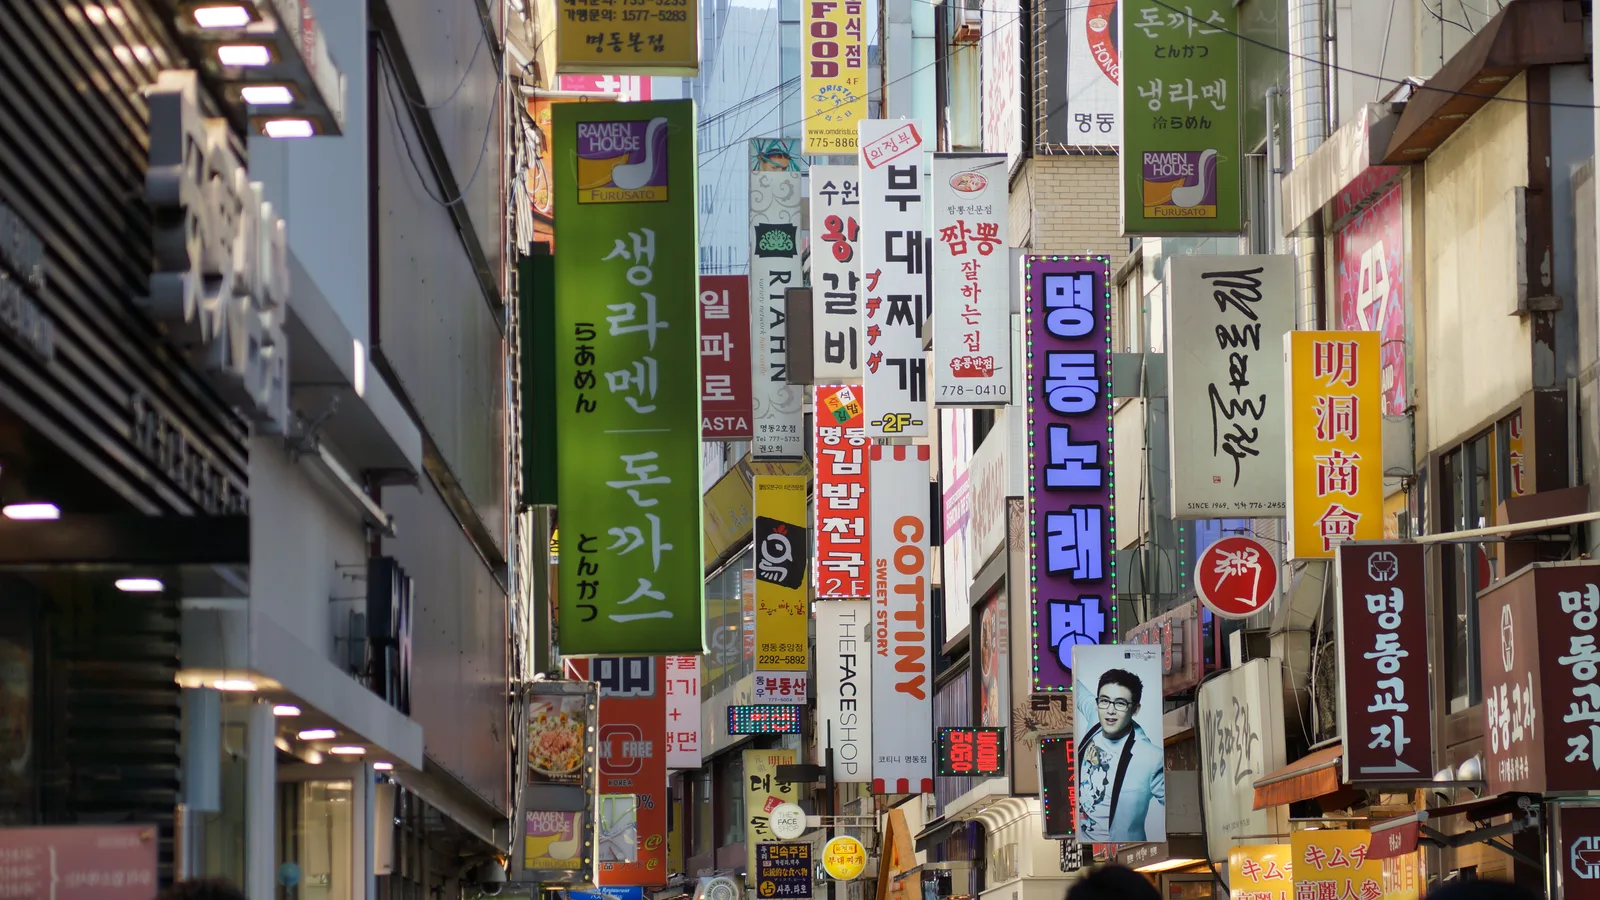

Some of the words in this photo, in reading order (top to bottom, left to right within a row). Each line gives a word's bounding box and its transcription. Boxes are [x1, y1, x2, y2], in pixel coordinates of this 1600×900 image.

[621, 10, 688, 21] 1577-5283
[1133, 5, 1228, 39] 돈까스
[585, 32, 665, 53] 명동본점
[810, 2, 839, 77] FOOD
[1154, 44, 1209, 59] とんかつ
[1137, 78, 1227, 112] 냉라멘
[578, 123, 631, 138] RAMEN
[1074, 112, 1115, 134] 명동
[590, 136, 640, 151] HOUSE
[870, 132, 911, 161] 의정부
[1144, 152, 1187, 165] RAMEN
[1153, 164, 1195, 176] HOUSE
[591, 190, 655, 201] FURUSATO
[1154, 208, 1207, 216] FURUSATO
[939, 219, 1003, 257] 짬뽕
[885, 165, 927, 402] 부대찌개
[601, 228, 670, 414] 생라멘
[573, 322, 597, 414] らあめん
[941, 384, 1007, 396] 778-0410
[819, 426, 866, 446] 명동
[820, 448, 866, 578] 김밥천국
[605, 451, 674, 623] 돈까스
[576, 533, 599, 622] とんかつ
[875, 558, 888, 607] SWEET
[892, 515, 926, 702] COTTINY
[876, 610, 889, 658] STORY
[759, 655, 807, 665] 2292-5892
[1363, 587, 1411, 757] 명동교자
[765, 677, 806, 696] 부동산
[1487, 671, 1536, 755] 명동교자
[622, 740, 653, 759] FREE
[607, 778, 633, 787] KOREA
[526, 811, 565, 822] RAMEN
[533, 821, 571, 833] HOUSE
[777, 818, 798, 826] FACE
[1305, 844, 1369, 870] キムチ
